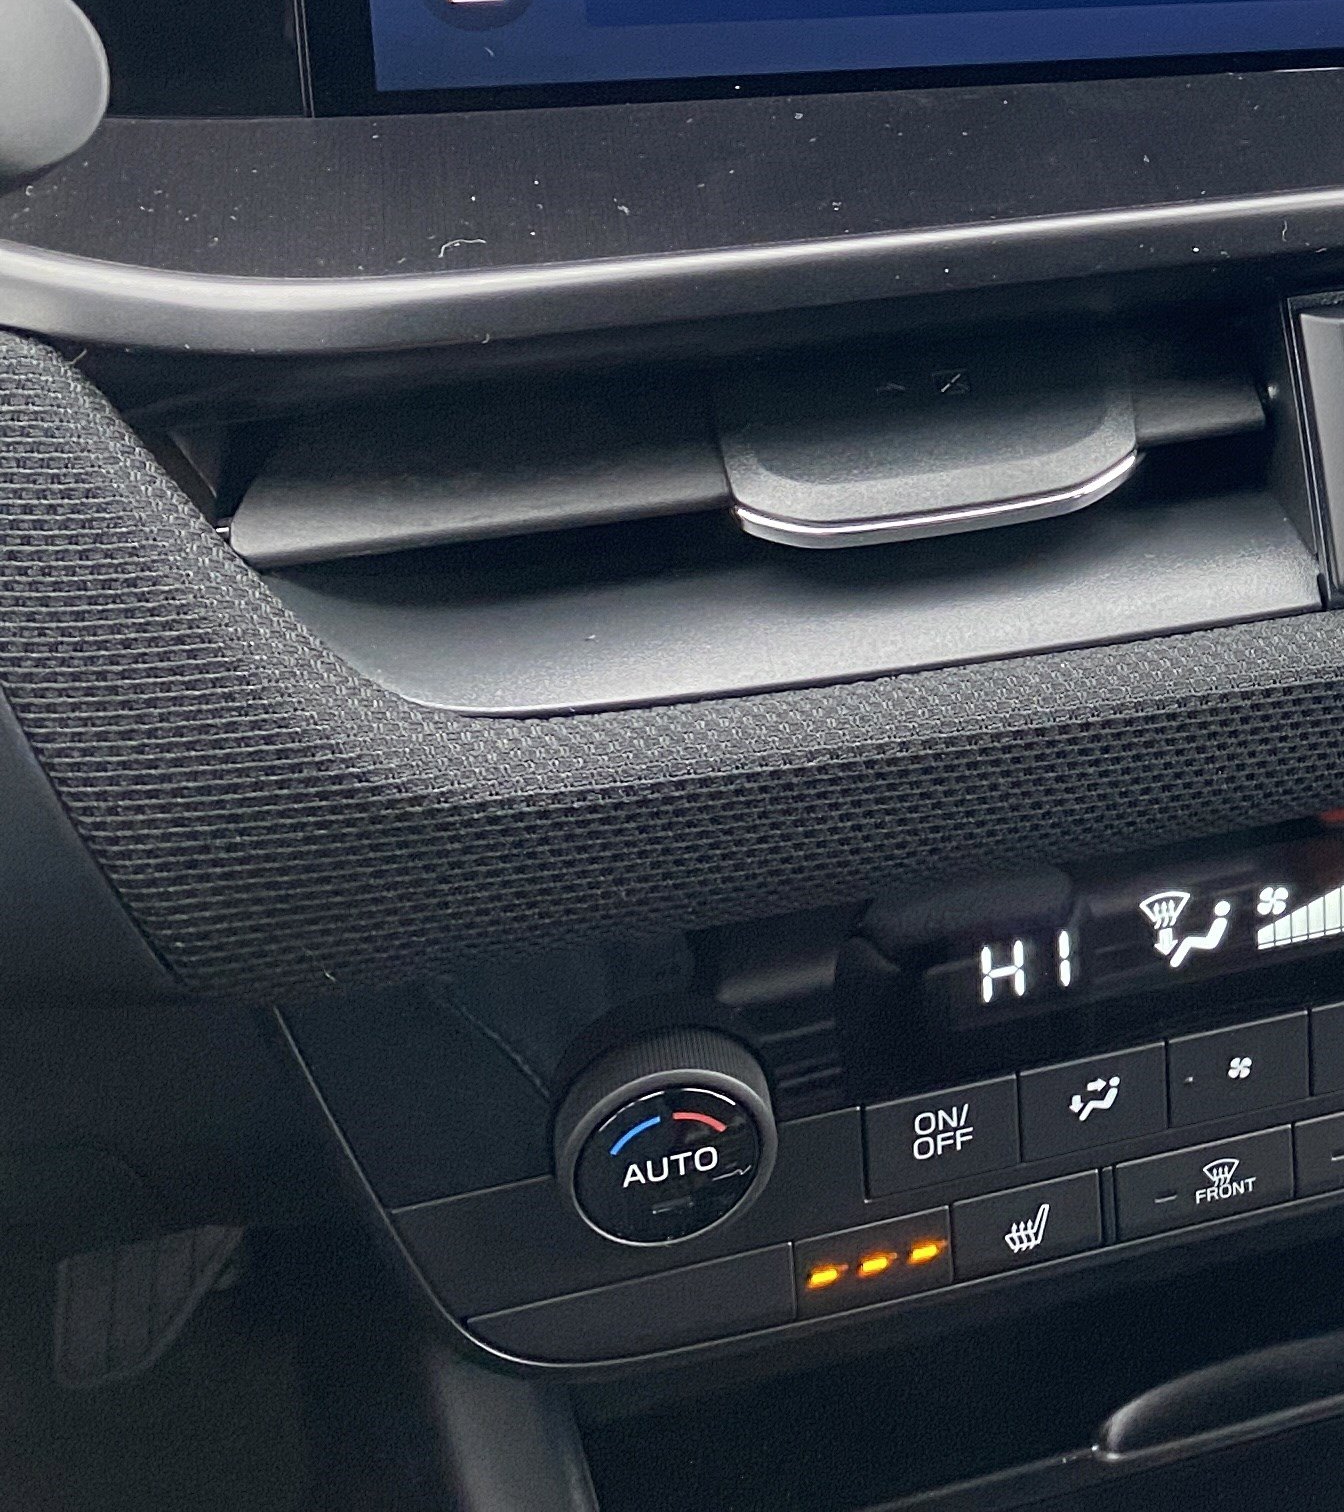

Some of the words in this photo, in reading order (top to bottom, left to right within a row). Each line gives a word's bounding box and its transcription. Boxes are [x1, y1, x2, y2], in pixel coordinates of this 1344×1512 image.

[979, 929, 1070, 1003] HI
[914, 1104, 969, 1136] ON/
[912, 1128, 974, 1160] OFF
[622, 1146, 719, 1188] AUTO
[1195, 1178, 1256, 1204] FRONT
